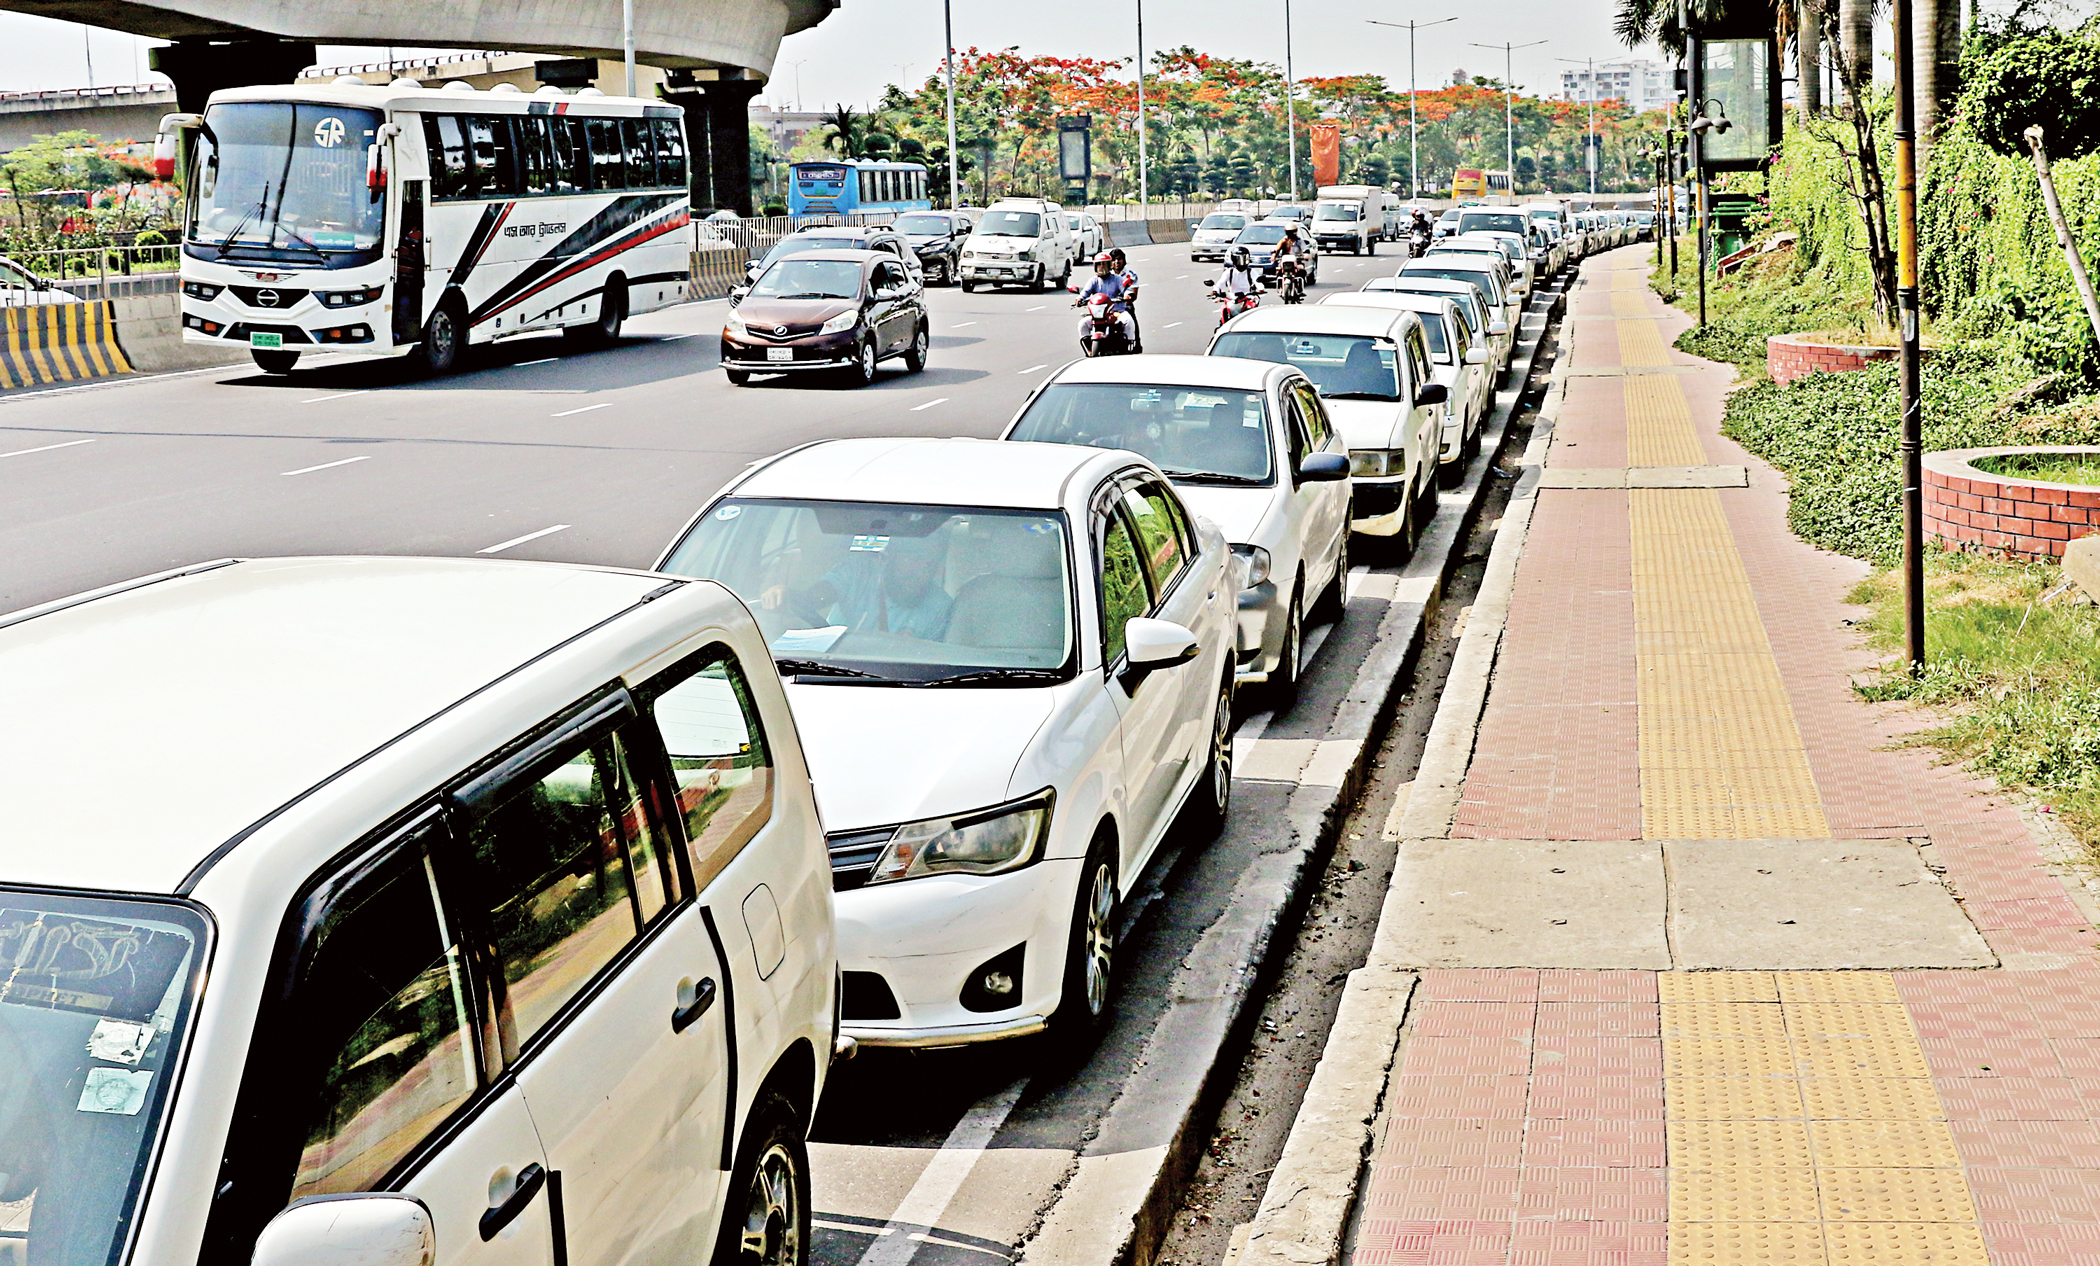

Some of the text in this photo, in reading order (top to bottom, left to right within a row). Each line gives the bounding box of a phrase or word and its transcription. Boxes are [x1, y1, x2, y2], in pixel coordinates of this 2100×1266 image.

[314, 117, 345, 147] SR
[504, 226, 518, 237] এস
[519, 225, 536, 237] আর
